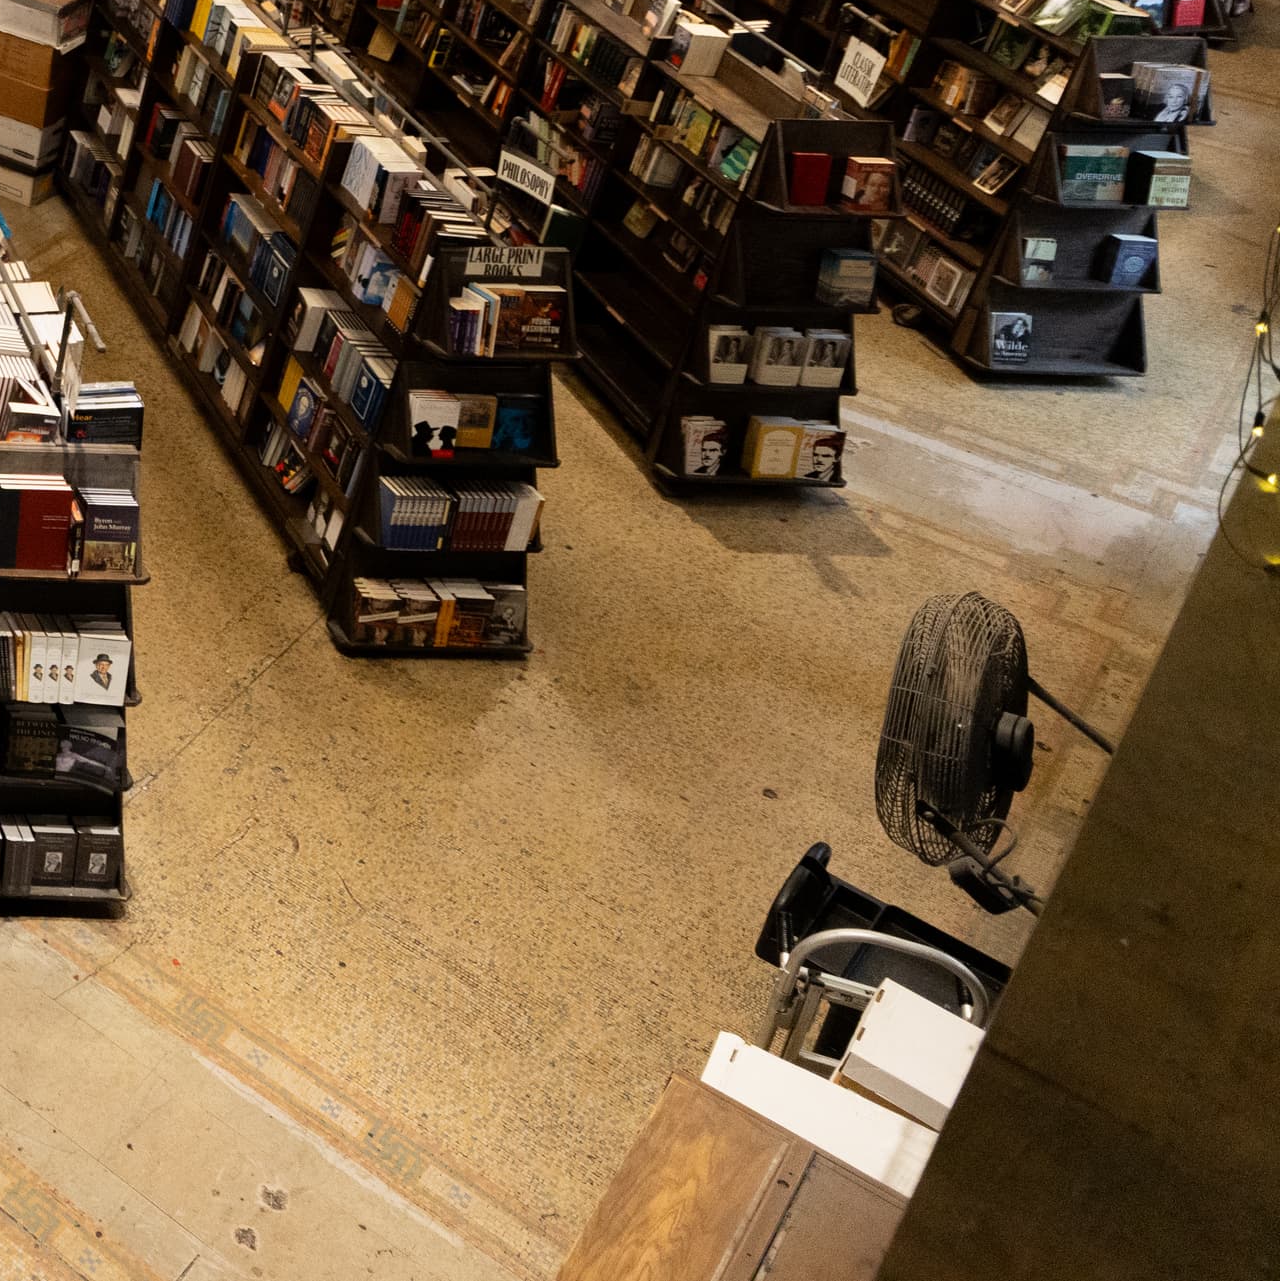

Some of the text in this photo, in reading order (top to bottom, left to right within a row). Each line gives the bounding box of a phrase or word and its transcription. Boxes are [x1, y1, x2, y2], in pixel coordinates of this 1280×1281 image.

[853, 51, 876, 78] CLASSIC
[840, 63, 873, 97] LITERATURE
[502, 159, 550, 200] PHILOSOPHY
[469, 247, 540, 264] LARGE PRINT
[484, 265, 523, 276] BOOKS
[522, 326, 560, 334] WASHINGTON
[995, 340, 1029, 350] Wilde
[110, 524, 131, 532] Murray
